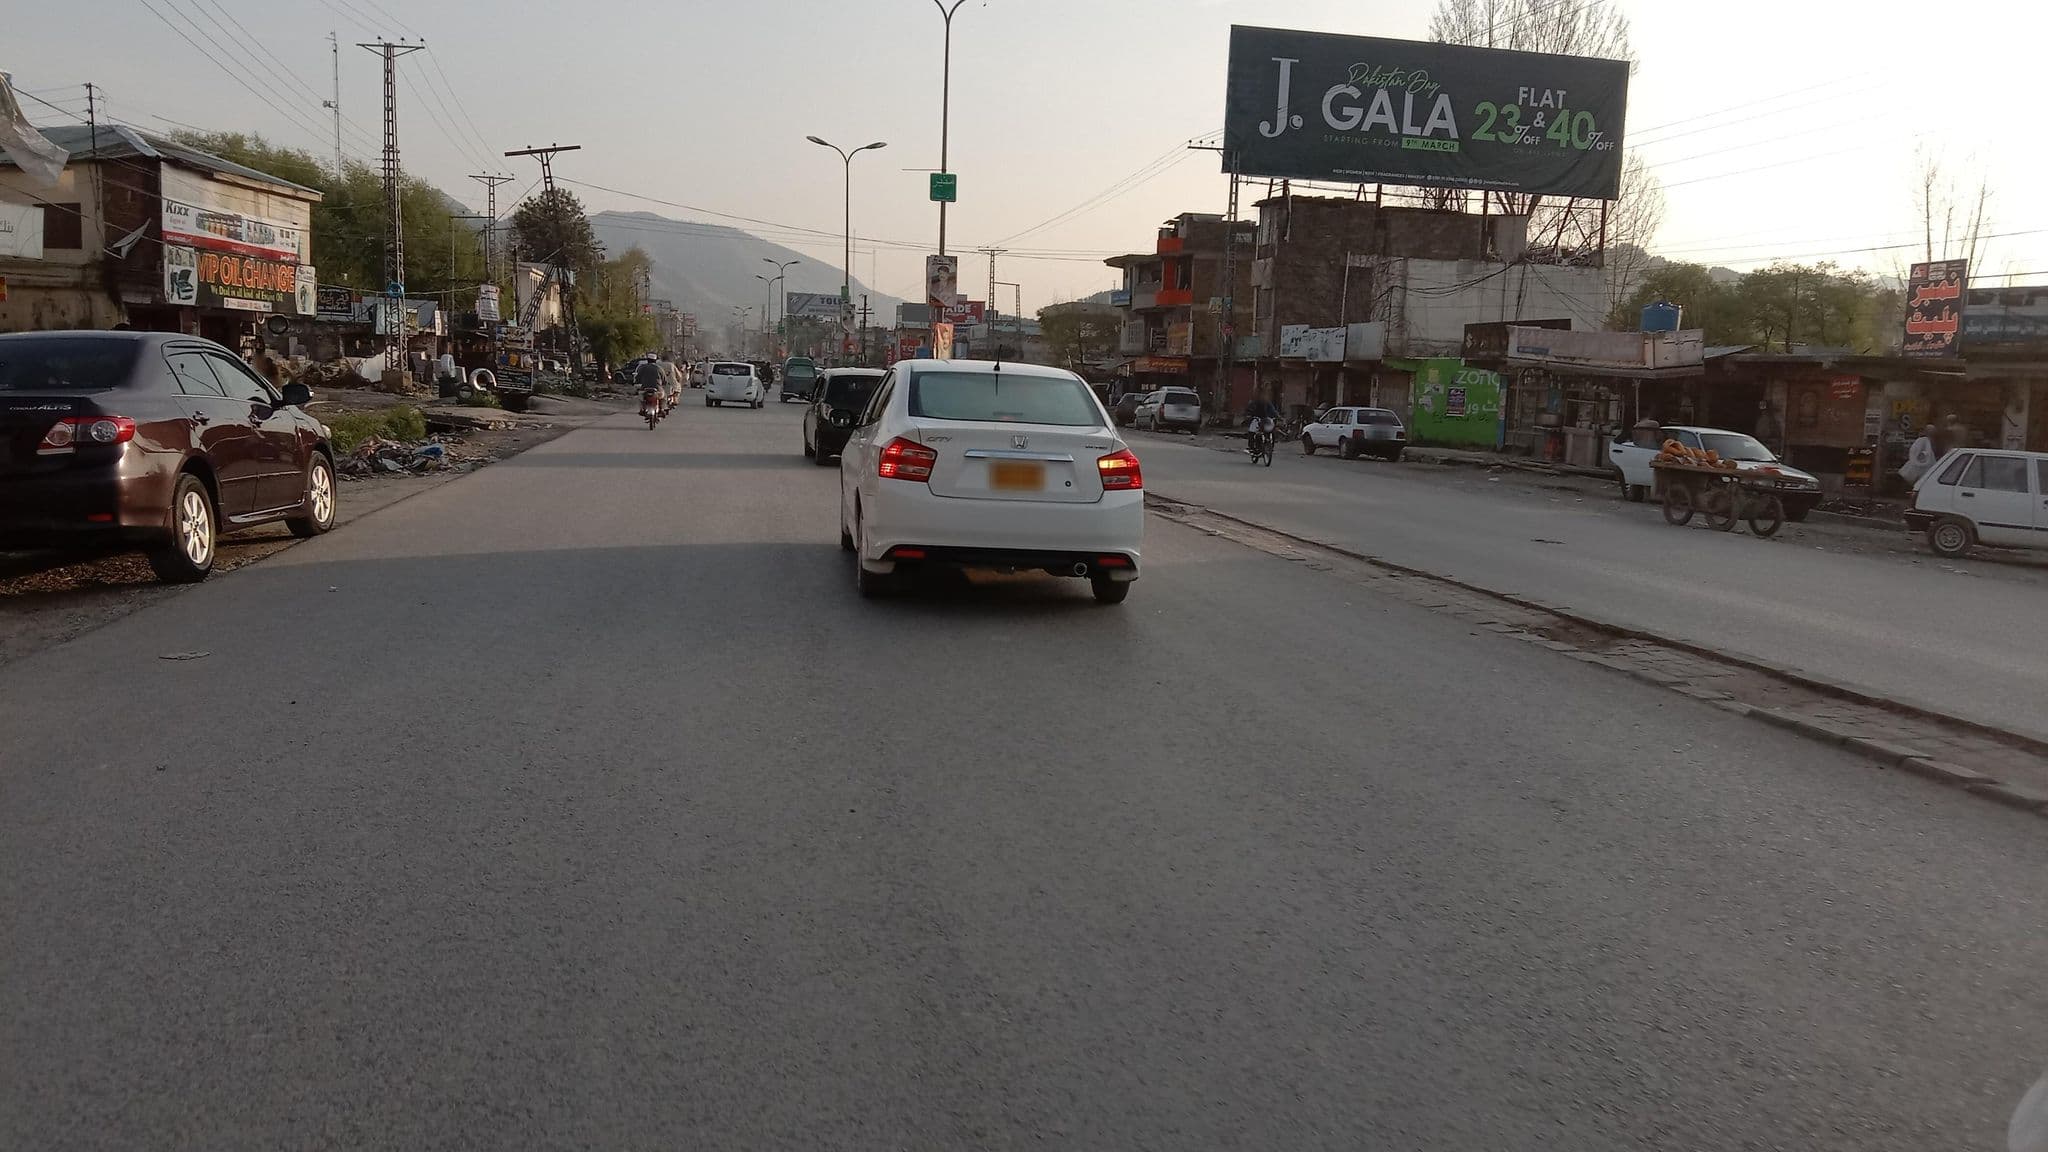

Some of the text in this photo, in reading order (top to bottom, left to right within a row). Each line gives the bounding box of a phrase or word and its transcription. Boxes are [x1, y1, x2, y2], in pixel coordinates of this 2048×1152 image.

[1258, 56, 1304, 138] J.
[1347, 62, 1441, 99] Pakistan Day
[1518, 86, 1567, 110] FLAT
[1321, 83, 1459, 139] GALA
[1421, 140, 1456, 151] MARCH
[197, 252, 219, 284] VIP
[219, 255, 243, 288] OIL
[242, 259, 296, 293] CHANGE
